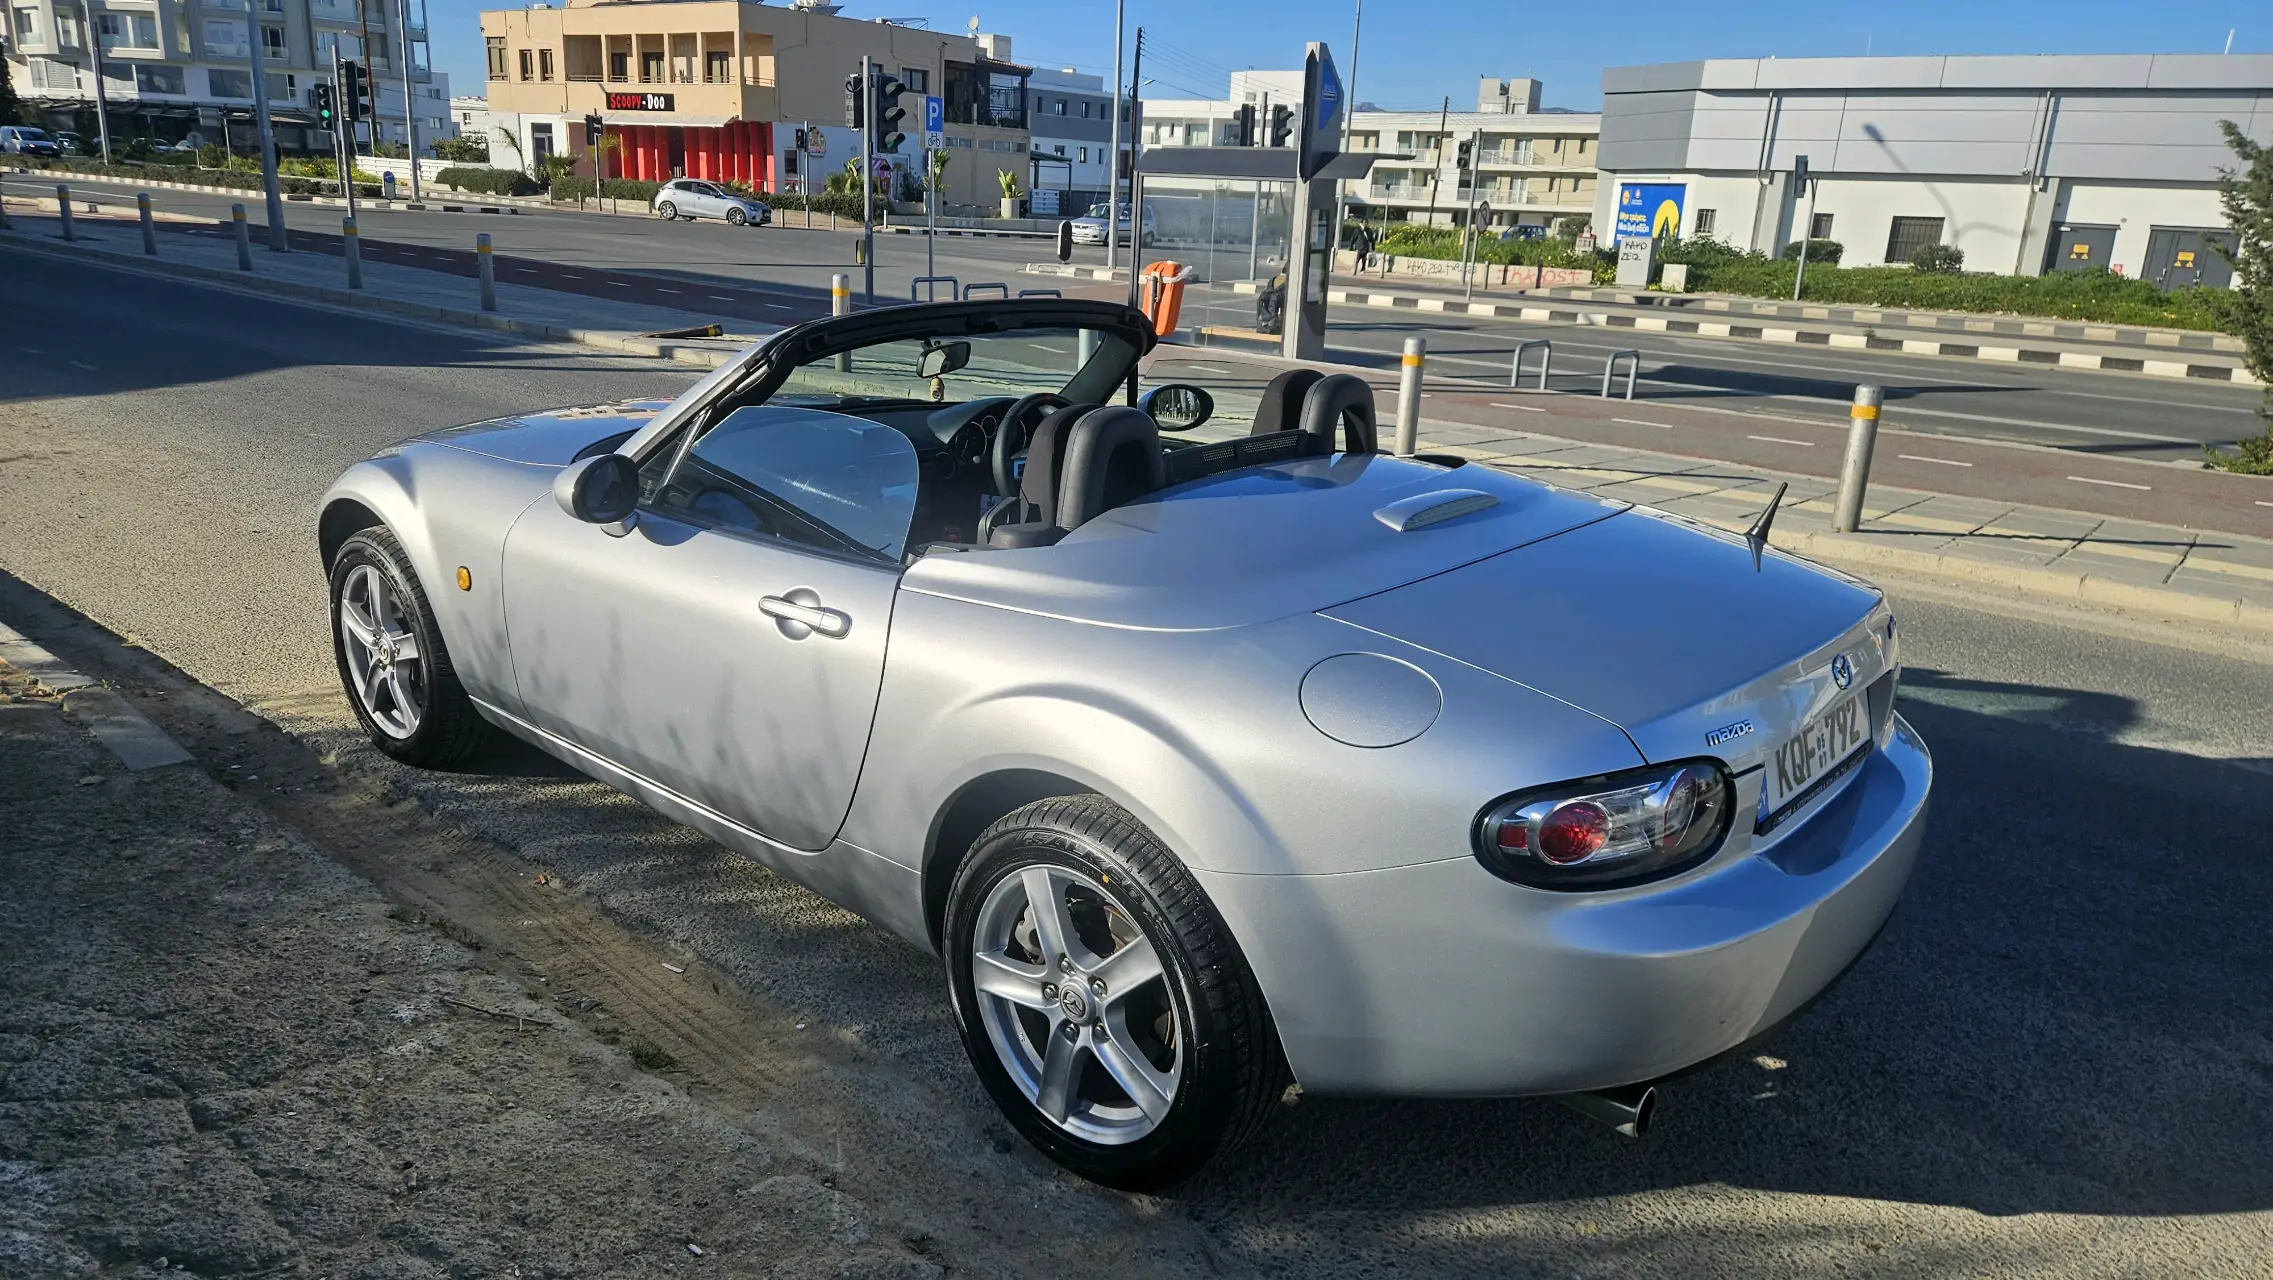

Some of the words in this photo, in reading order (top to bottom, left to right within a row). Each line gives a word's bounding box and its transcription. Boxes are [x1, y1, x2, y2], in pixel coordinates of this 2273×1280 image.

[930, 101, 939, 126] P
[1775, 725, 1816, 798] KQF
[1824, 696, 1861, 761] 792
